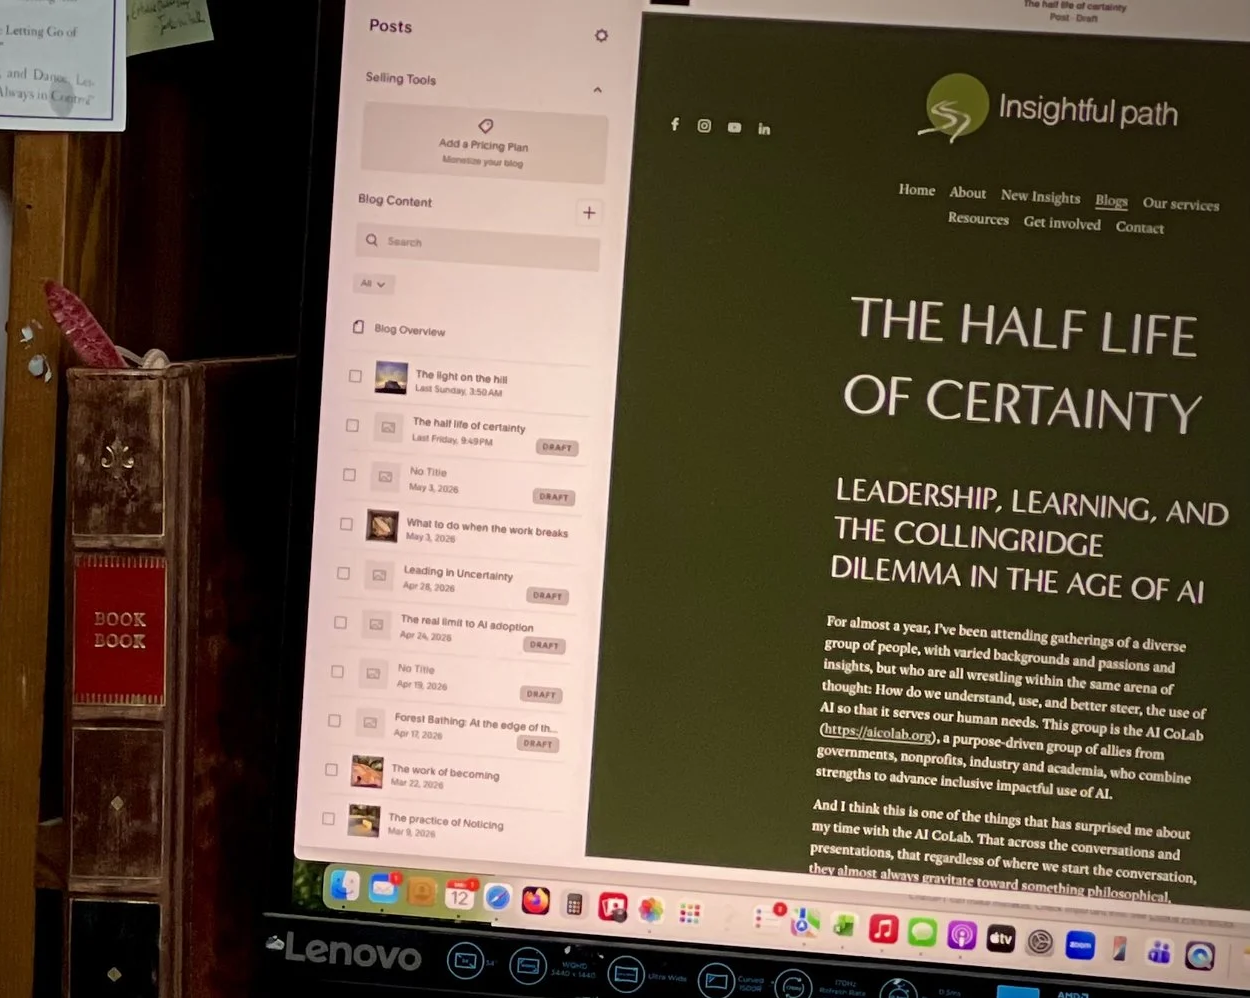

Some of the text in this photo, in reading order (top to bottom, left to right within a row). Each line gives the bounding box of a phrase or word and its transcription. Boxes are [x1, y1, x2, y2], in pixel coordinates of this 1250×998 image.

[370, 18, 412, 34] Posts
[366, 71, 436, 86] Selling Tools
[1000, 93, 1178, 130] Insightful path
[439, 138, 460, 148] Add
[470, 140, 506, 153] Pricing
[508, 142, 529, 152] Plan
[899, 183, 936, 196] Home
[949, 186, 986, 199] About
[358, 193, 432, 208] Blog Content
[1001, 189, 1081, 207] New Insights
[1095, 194, 1128, 212] Blogs
[360, 279, 372, 287] All
[374, 323, 446, 337] Blog Overview
[851, 296, 1198, 357] THE HALF LIFE
[416, 369, 508, 384] The light on the hill
[844, 374, 1203, 435] OF CERTAINTY
[413, 416, 526, 435] The half life of certainty
[542, 443, 572, 452] DRAFT
[410, 466, 447, 478] No Title
[837, 477, 1229, 526] LEADERSHIP, LEARNING, AND
[406, 518, 569, 538] What to do when the work breaks
[834, 516, 1104, 558] THE COLLINGRIDGE
[404, 565, 514, 583] Leading in Uncertainty
[831, 555, 1204, 604] DILEMMA IN THE AGE OF AI
[94, 612, 146, 627] BOOK
[94, 633, 146, 648] BOOK
[827, 615, 1187, 653] For almost a year, I've been attending gatherings of a diverse
[451, 890, 468, 906] 12
[285, 931, 422, 971] Lenovo
